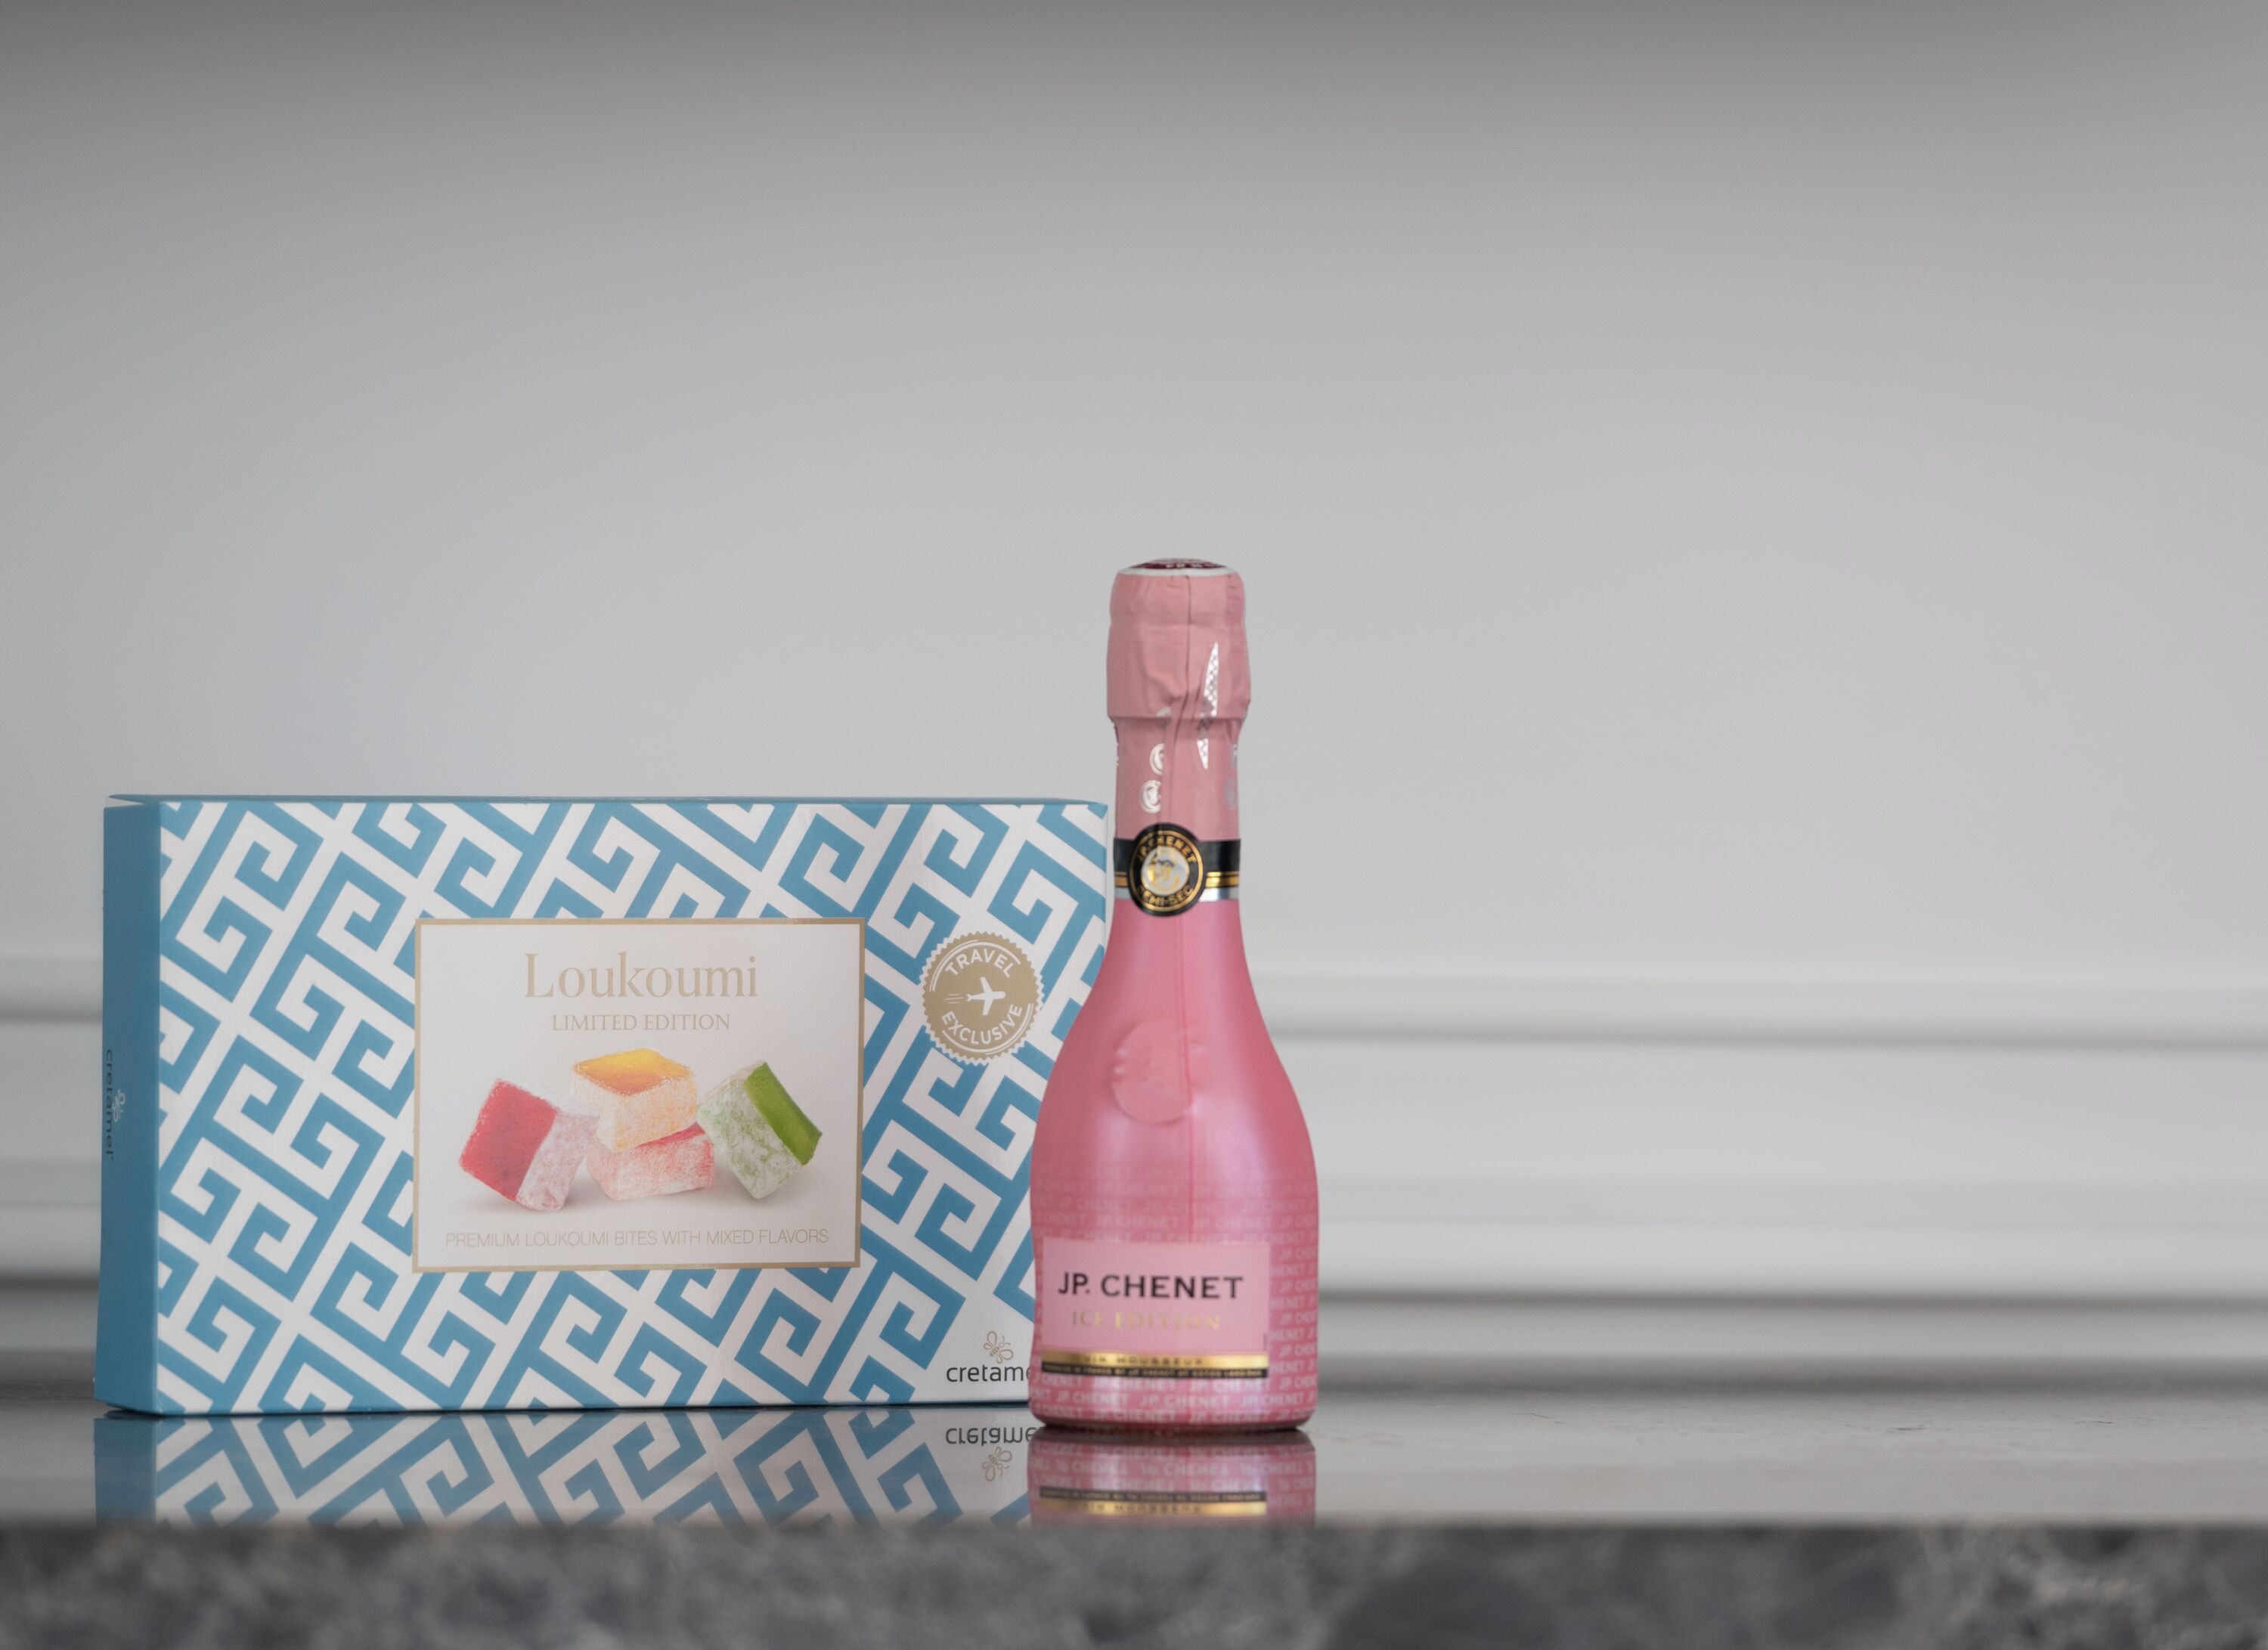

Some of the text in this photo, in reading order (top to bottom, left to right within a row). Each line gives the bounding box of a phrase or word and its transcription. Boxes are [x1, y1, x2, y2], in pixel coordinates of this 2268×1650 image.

[525, 951, 758, 998] Loukoumi
[945, 948, 1015, 978] TRAVEL
[550, 1014, 731, 1031] LIMITED EDITION
[942, 1004, 1022, 1045] EXCLUSIVE
[446, 1228, 829, 1247] PREMIUM LOUKOUMI BITES WITH MIXED FLAVORS
[1058, 1272, 1243, 1299] JP. CHENET
[1073, 1311, 1221, 1330] ICE EDITION
